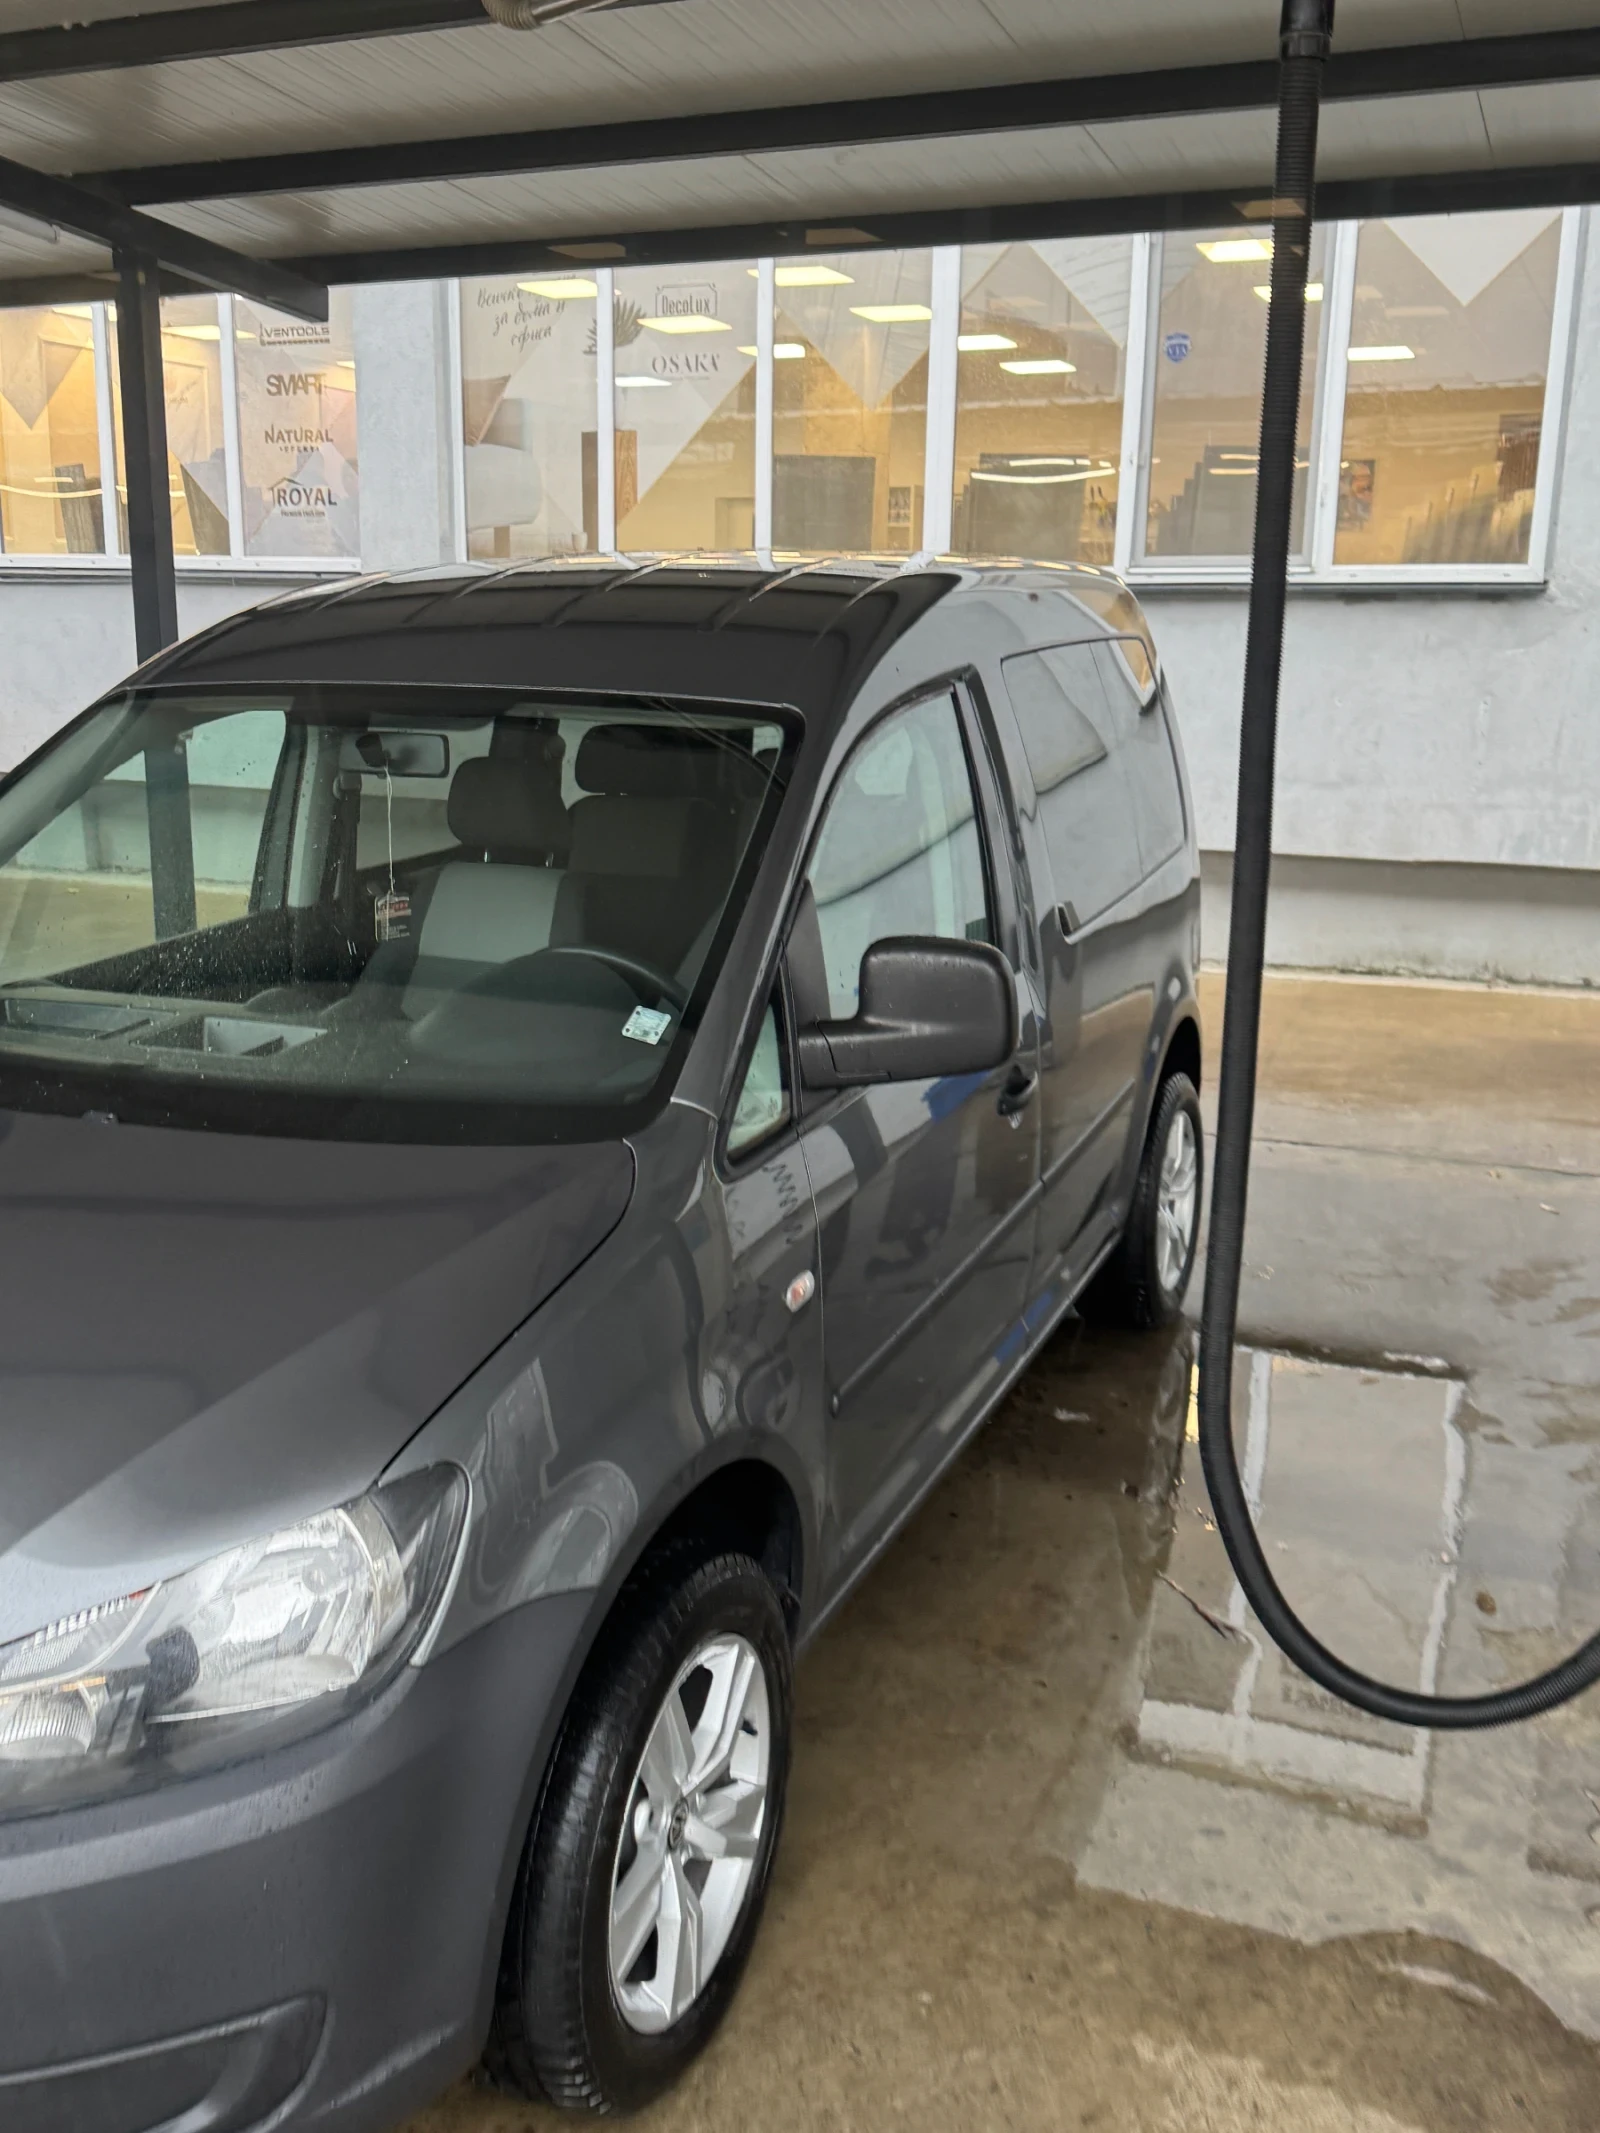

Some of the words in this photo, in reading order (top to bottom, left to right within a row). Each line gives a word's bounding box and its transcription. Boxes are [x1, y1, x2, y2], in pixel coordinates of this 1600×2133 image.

[652, 353, 720, 373] OSAKA
[266, 373, 326, 396] SMART
[264, 424, 334, 443] NATURAL
[277, 487, 337, 507] ROYAL
